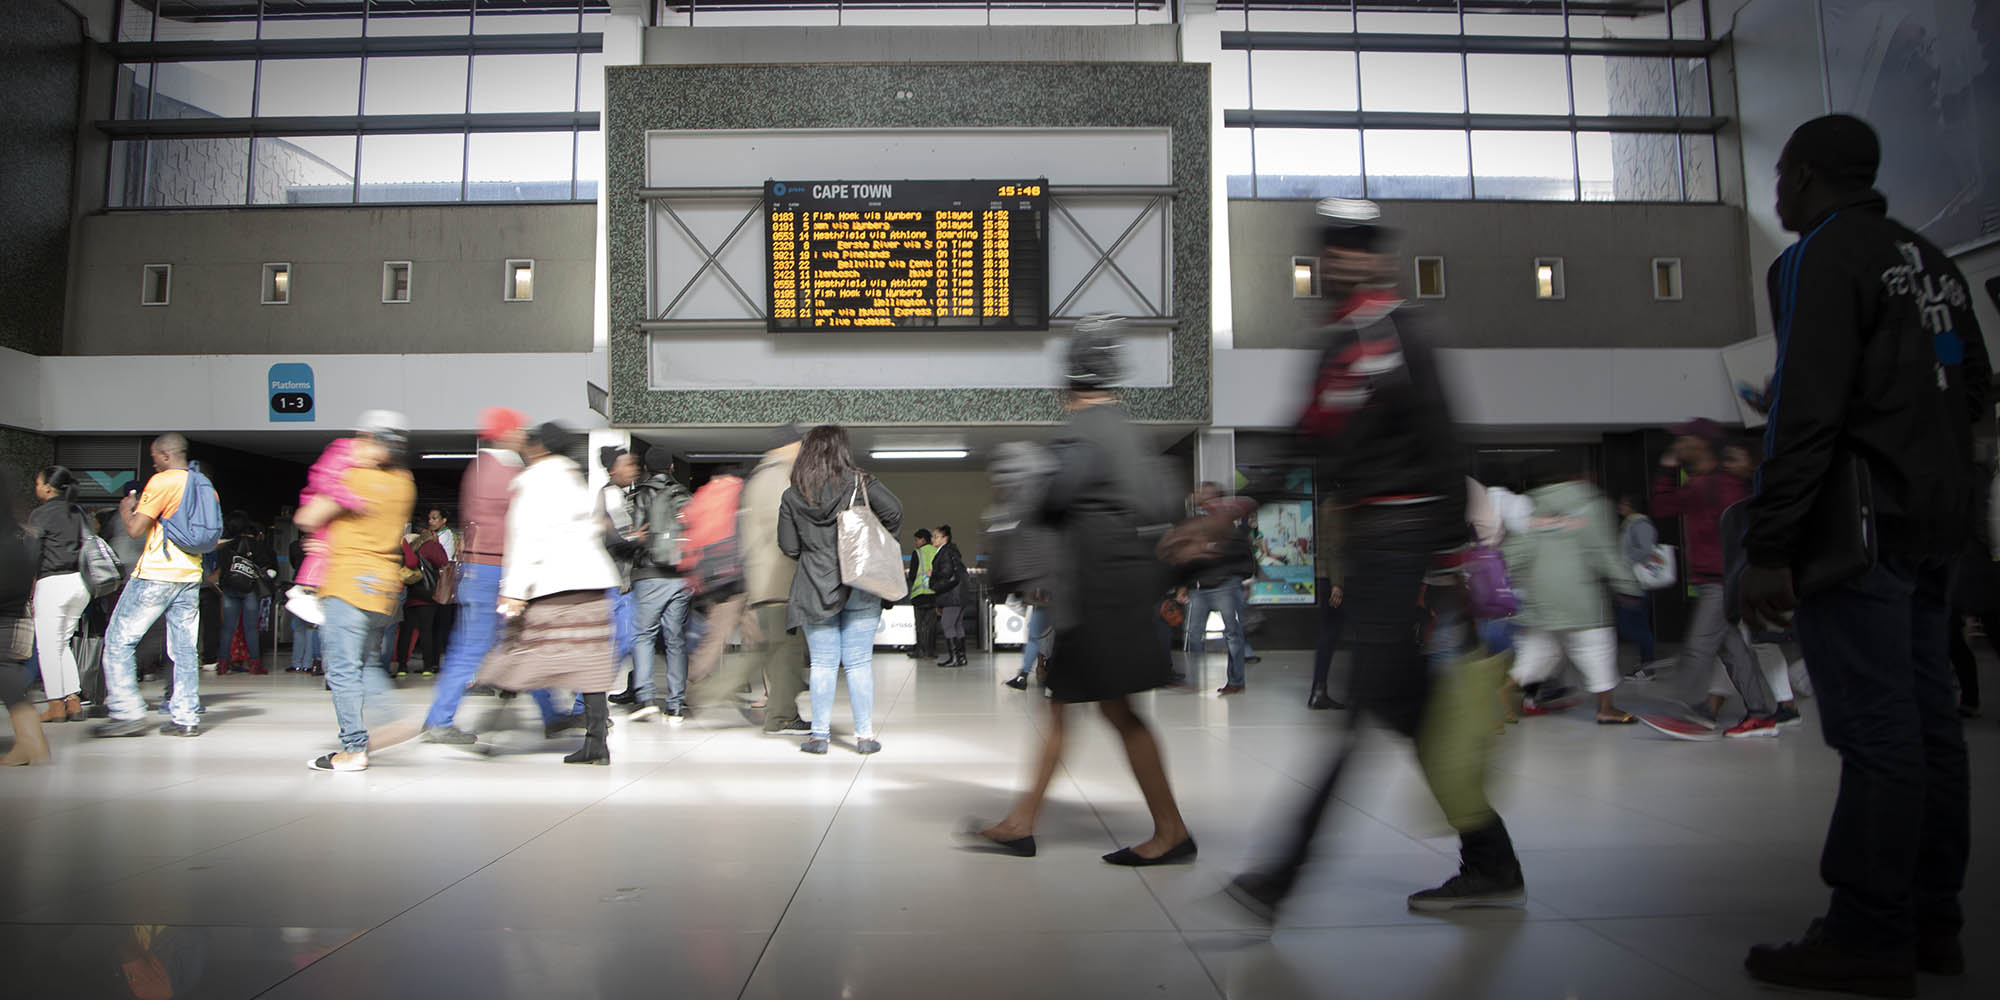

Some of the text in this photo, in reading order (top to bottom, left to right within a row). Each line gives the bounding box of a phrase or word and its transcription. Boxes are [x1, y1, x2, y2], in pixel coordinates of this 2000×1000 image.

[812, 184, 892, 199] CAPE TOWN
[813, 212, 835, 221] Fish
[838, 212, 859, 220] Hoek
[864, 212, 881, 221] via
[884, 211, 922, 220] Wynberg
[936, 211, 973, 220] Delayed
[832, 221, 850, 229] via
[852, 221, 890, 230] Wynberg
[936, 222, 973, 230] Delayed
[813, 231, 866, 240] Heathfield
[869, 231, 886, 240] via
[890, 231, 928, 240] Athlone
[936, 230, 978, 239] Boarding
[837, 241, 870, 250] Eerste
[872, 240, 900, 250] River
[903, 240, 921, 248] via
[936, 240, 948, 249] On
[952, 240, 973, 249] Time
[822, 250, 840, 259] via
[842, 250, 891, 259] Pinelands
[936, 250, 948, 259] On
[952, 249, 973, 258] Time
[837, 260, 886, 269] Bellville
[888, 260, 906, 268] via
[936, 259, 948, 268] On
[952, 259, 973, 268] Time
[936, 269, 948, 278] On
[952, 269, 973, 278] Time
[814, 280, 866, 289] Heathfield
[870, 279, 887, 287] via
[890, 279, 928, 288] Athlone
[936, 278, 948, 288] On
[952, 278, 974, 288] Time
[814, 289, 836, 298] Fish
[840, 289, 860, 298] Hoek
[865, 289, 882, 297] via
[885, 289, 923, 298] Wynberg
[936, 288, 948, 297] On
[952, 288, 974, 297] Time
[873, 298, 927, 308] Wellington
[936, 298, 948, 307] On
[952, 298, 974, 307] Time
[858, 308, 890, 316] Mutual
[894, 308, 932, 317] Express
[936, 308, 948, 317] On
[952, 307, 974, 316] Time
[271, 380, 311, 390] Platforms
